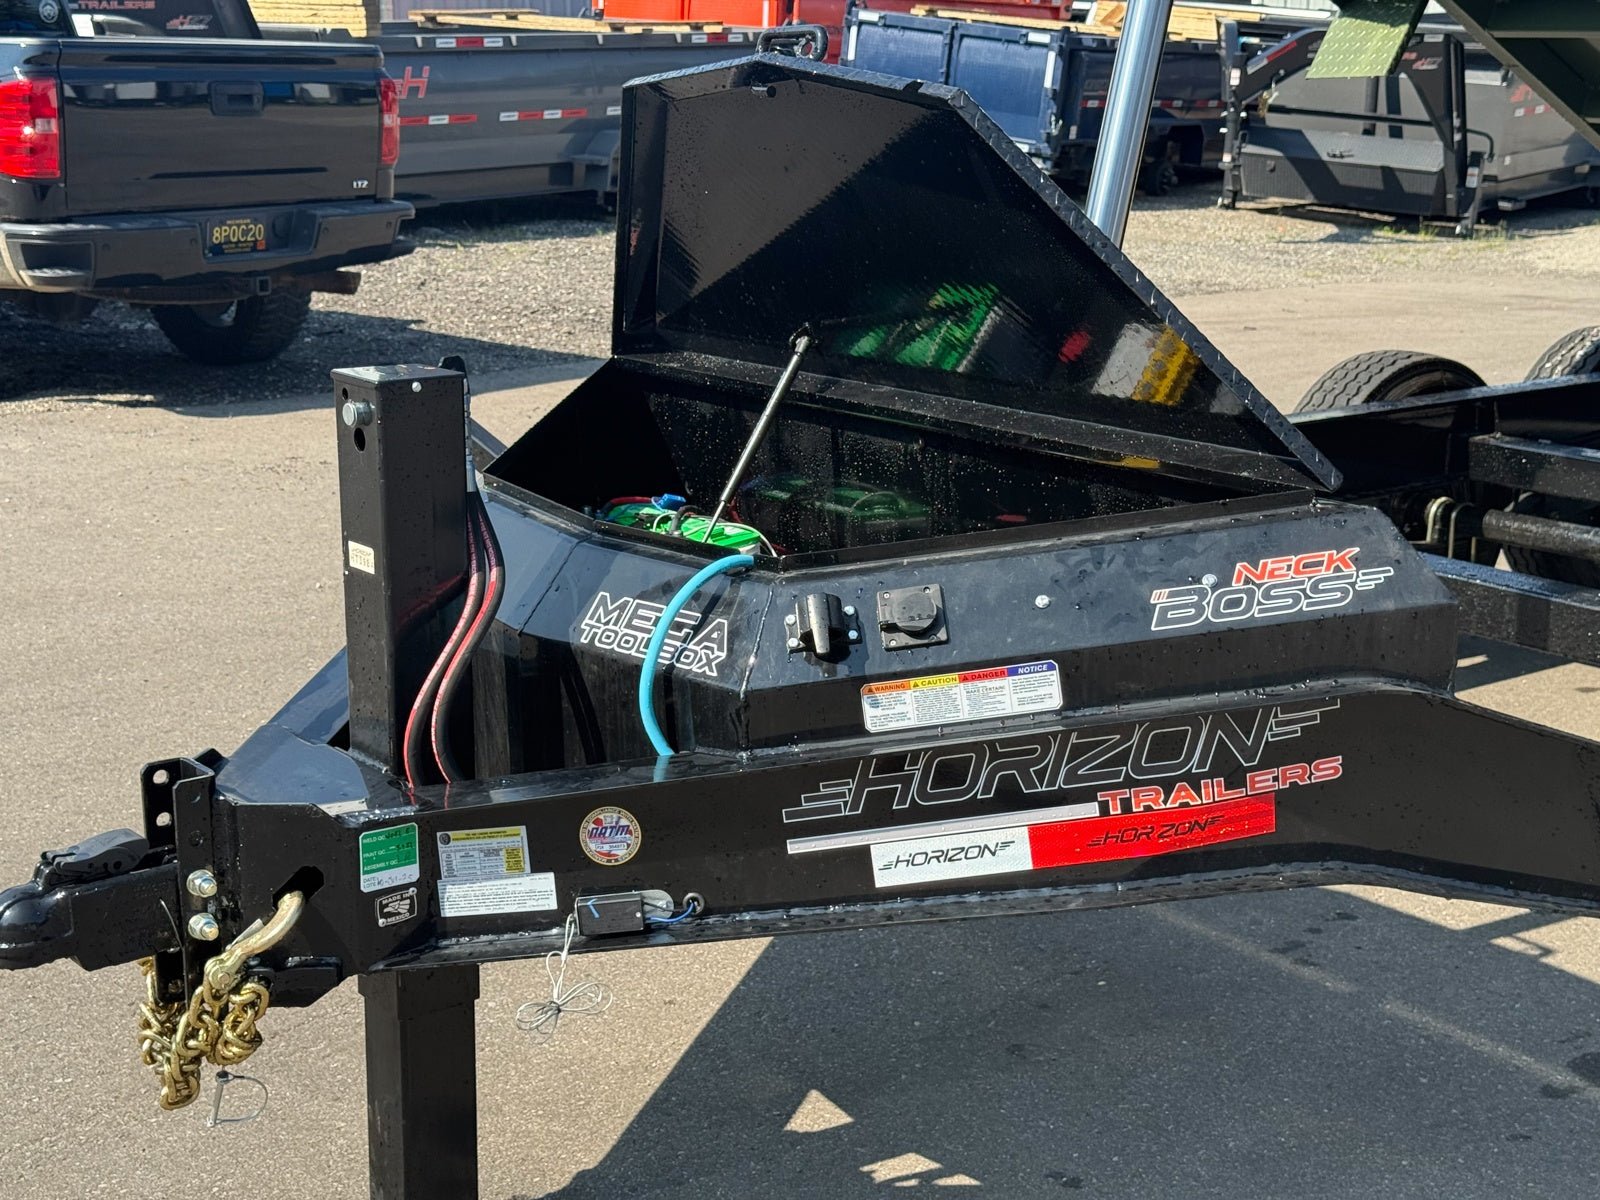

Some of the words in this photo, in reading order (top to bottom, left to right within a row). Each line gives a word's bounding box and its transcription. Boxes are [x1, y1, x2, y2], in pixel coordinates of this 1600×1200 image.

[1232, 547, 1361, 586] NECK
[1149, 571, 1358, 631] BOSS
[970, 670, 1006, 681] DANGER
[1017, 663, 1049, 674] NOTICE
[874, 683, 906, 693] WARNING
[920, 676, 958, 687] CAUTION
[845, 704, 1280, 815] HORIZON
[1096, 755, 1344, 815] TRAILERS
[588, 824, 631, 839] NATM
[1102, 820, 1210, 847] HORZON
[893, 841, 1000, 869] HORIZON
[381, 894, 402, 905] MADE
[386, 912, 411, 923] MEXICO
